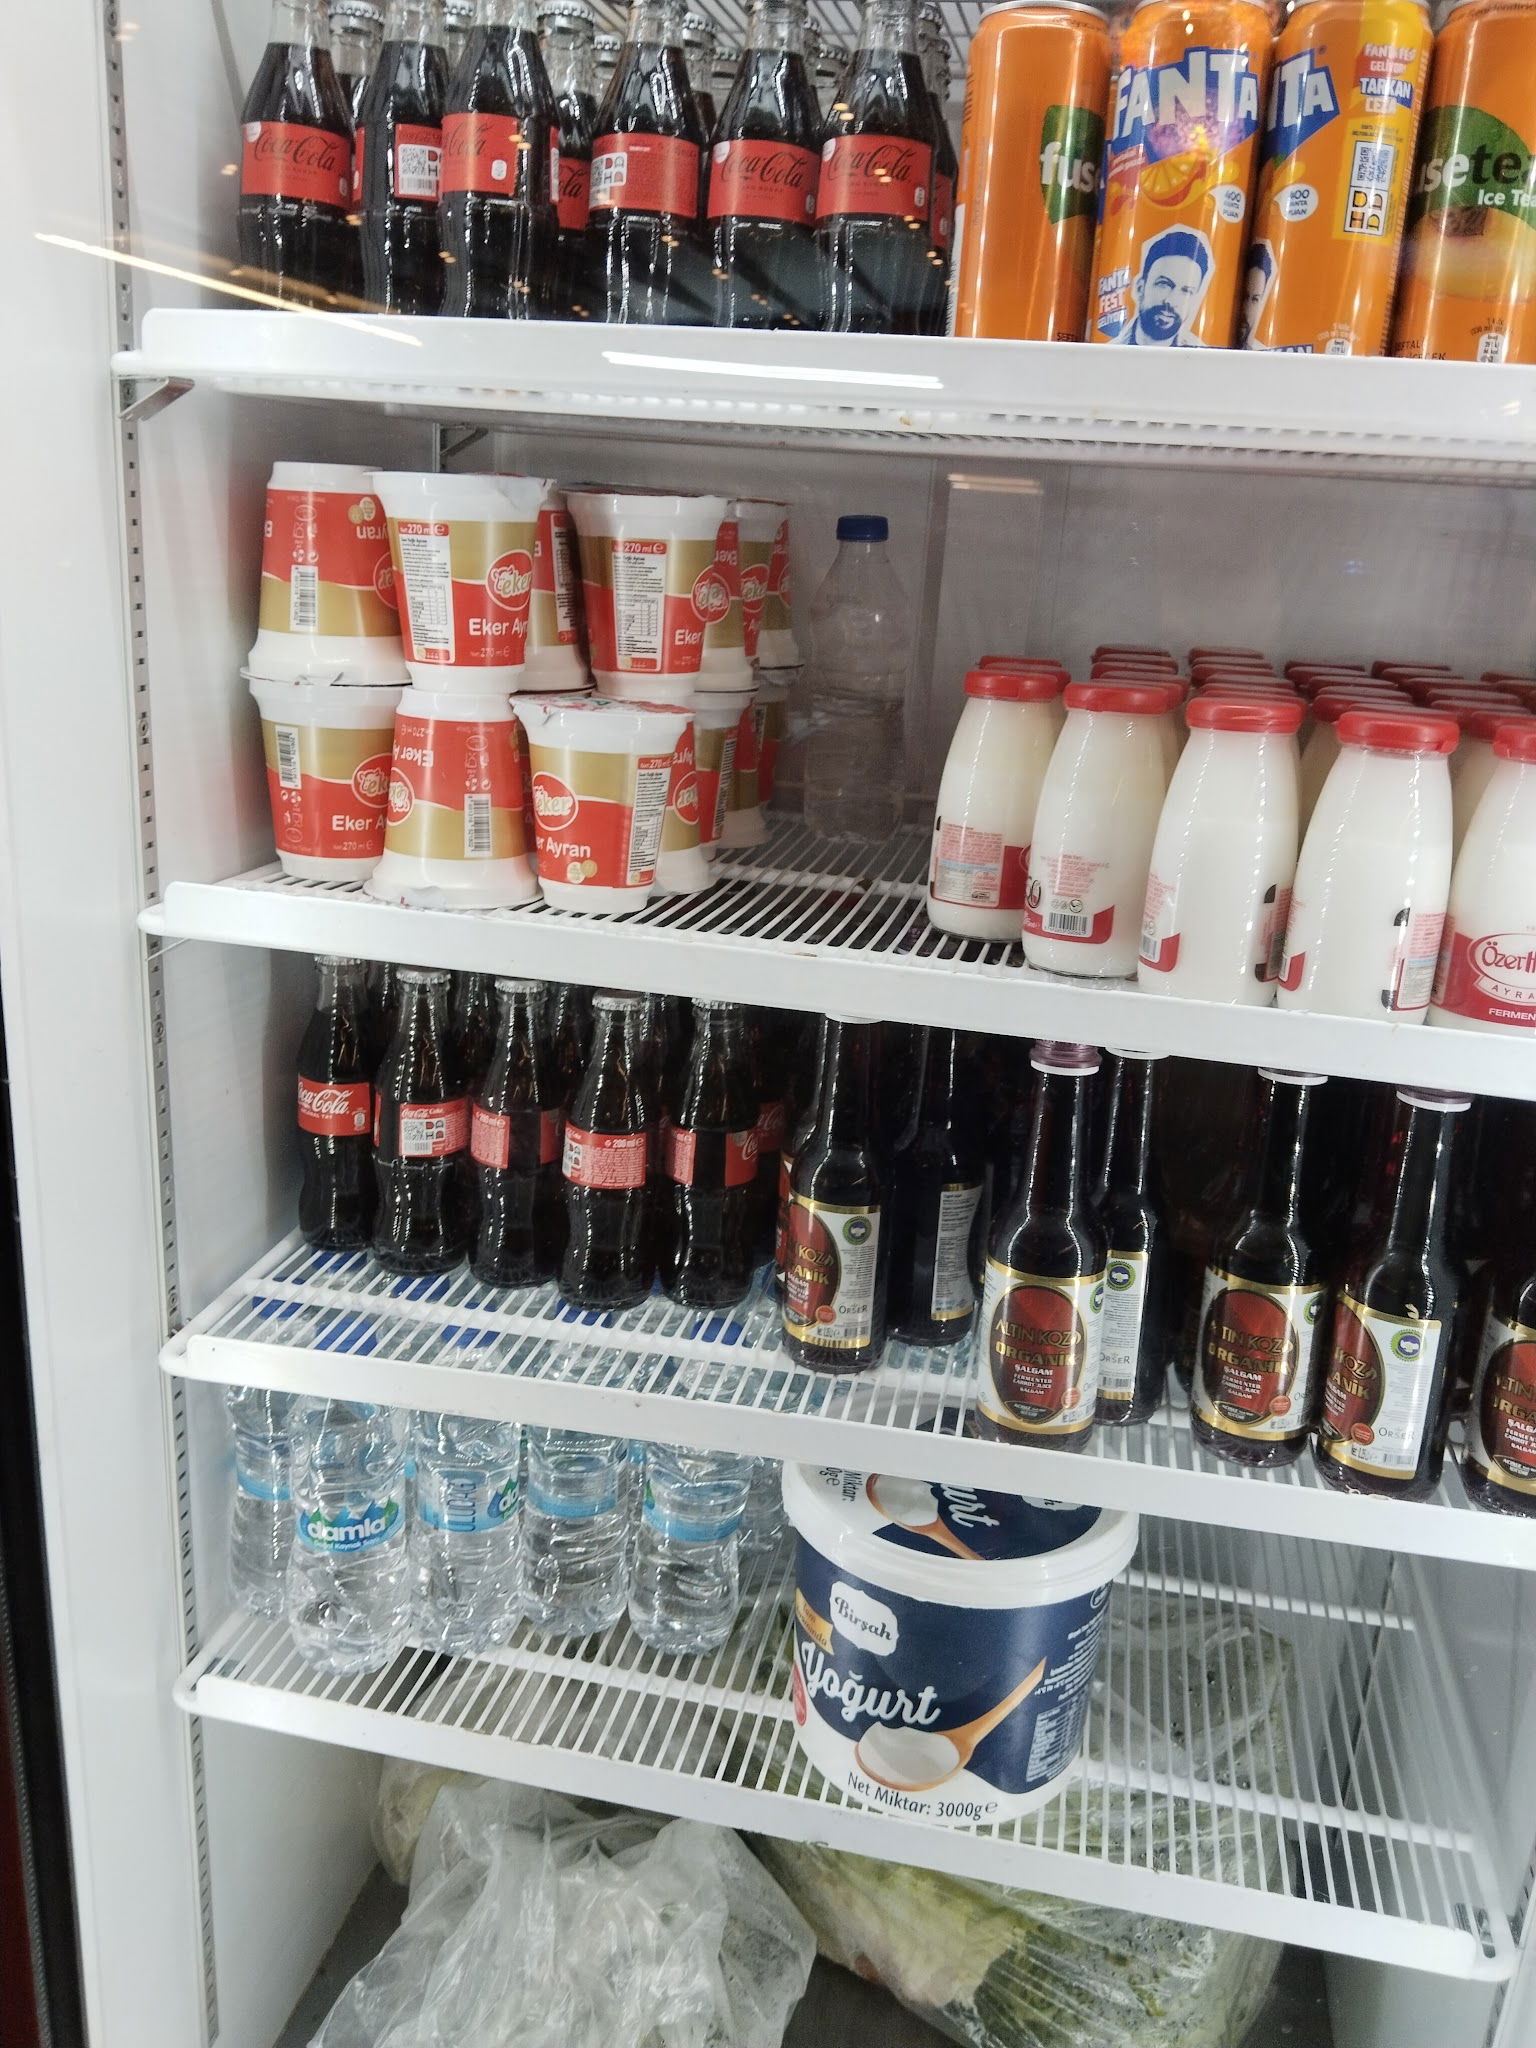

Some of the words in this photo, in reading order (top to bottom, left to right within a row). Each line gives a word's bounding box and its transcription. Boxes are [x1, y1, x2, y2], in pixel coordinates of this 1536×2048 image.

[1114, 50, 1258, 139] FANTA
[1360, 78, 1412, 99] TARKAN
[1040, 141, 1102, 192] fus
[1477, 189, 1506, 206] Ice
[407, 523, 422, 534] 270
[624, 543, 640, 553] 270
[641, 545, 652, 553] ml
[469, 618, 509, 637] Eker
[512, 617, 529, 638] Ayr
[480, 646, 494, 657] 270
[401, 747, 434, 768] Eker
[650, 759, 662, 769] 270
[332, 814, 373, 831] Eker
[546, 837, 591, 859] Ayran
[995, 1341, 1077, 1367] ORGANİK
[307, 1518, 386, 1542] damla
[834, 1596, 893, 1641] Birşah
[801, 1642, 942, 1725] Yoğurt
[847, 1771, 874, 1797] Net
[874, 1788, 931, 1816] Miktar:
[935, 1800, 983, 1821] 3000g
